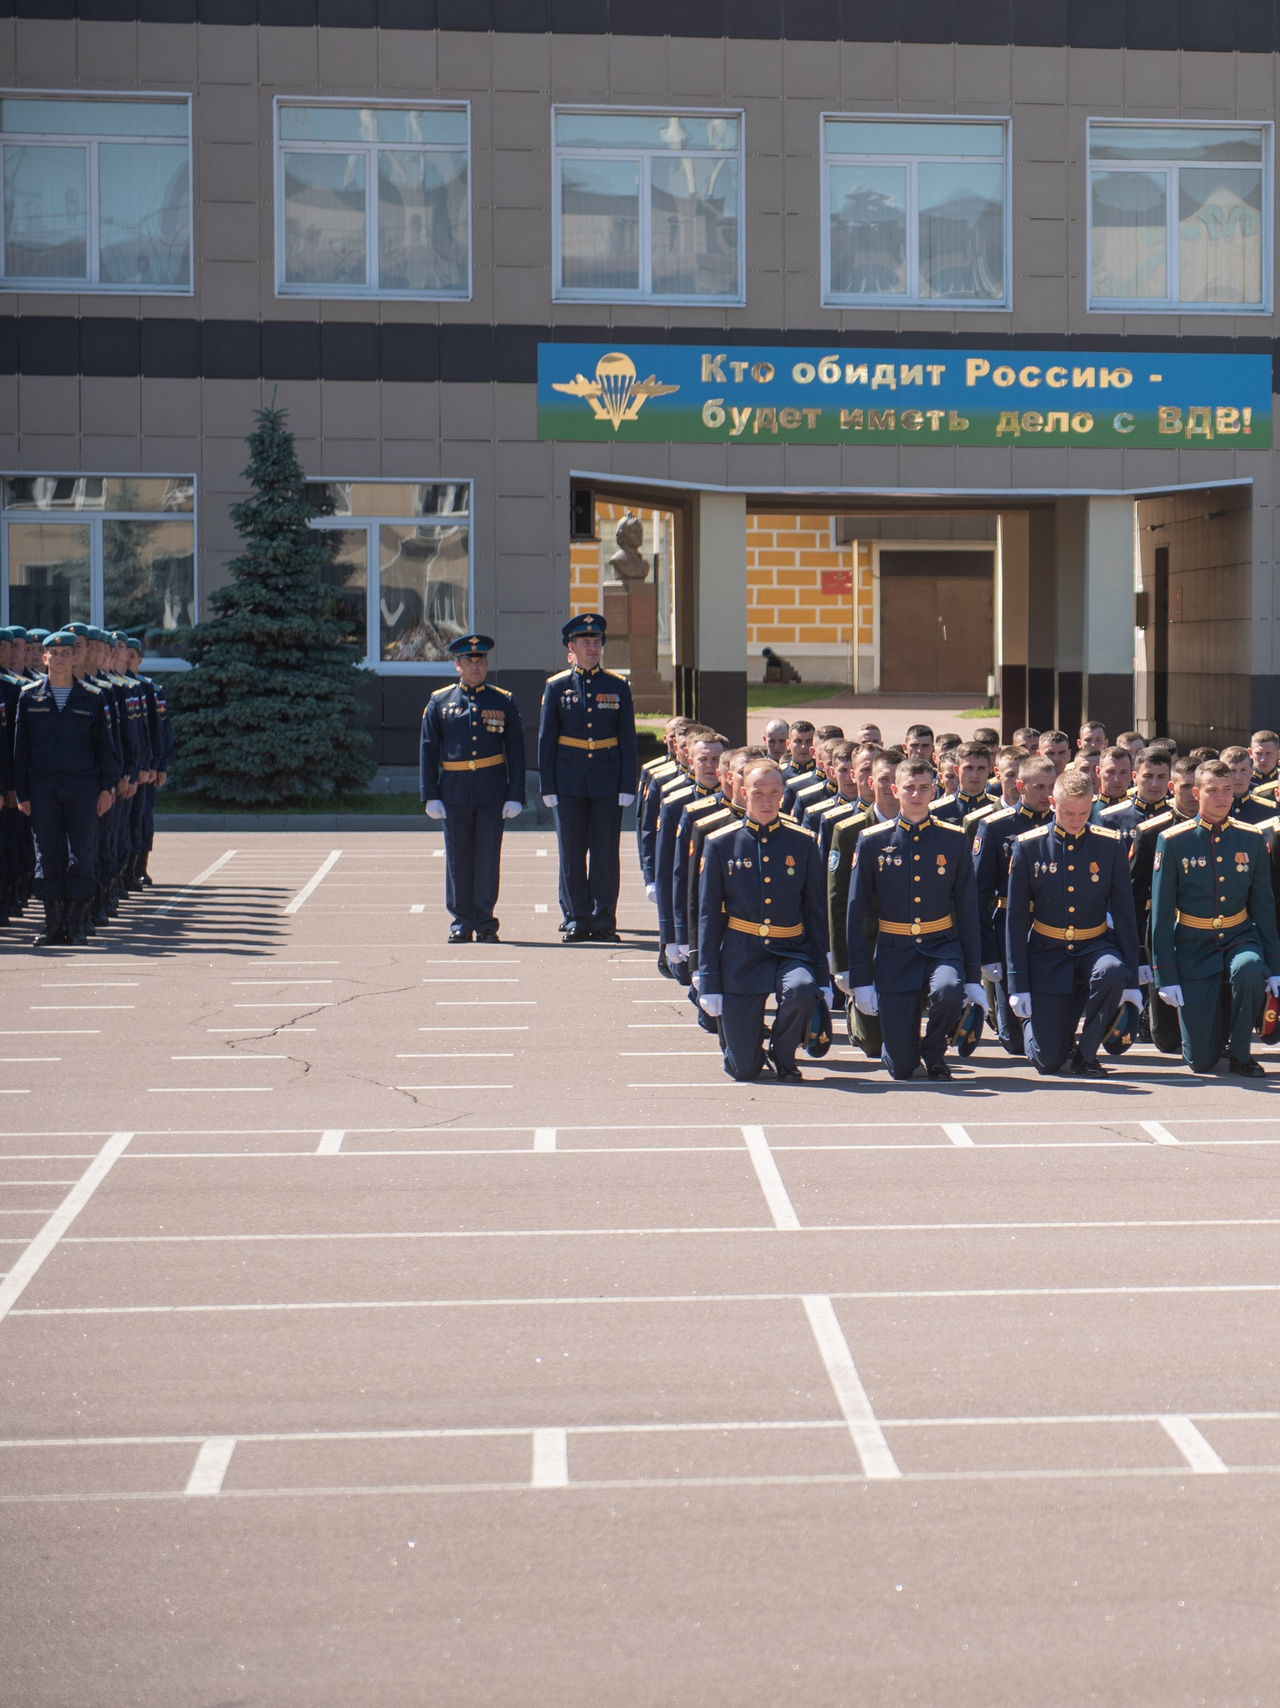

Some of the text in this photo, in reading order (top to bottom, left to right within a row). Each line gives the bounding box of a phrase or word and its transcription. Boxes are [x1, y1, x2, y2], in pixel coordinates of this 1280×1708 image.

[701, 353, 776, 383] Кто
[791, 354, 946, 390] обидит
[965, 357, 1133, 389] Россию
[701, 398, 1252, 439] будет иметь дело с ВДВ!
